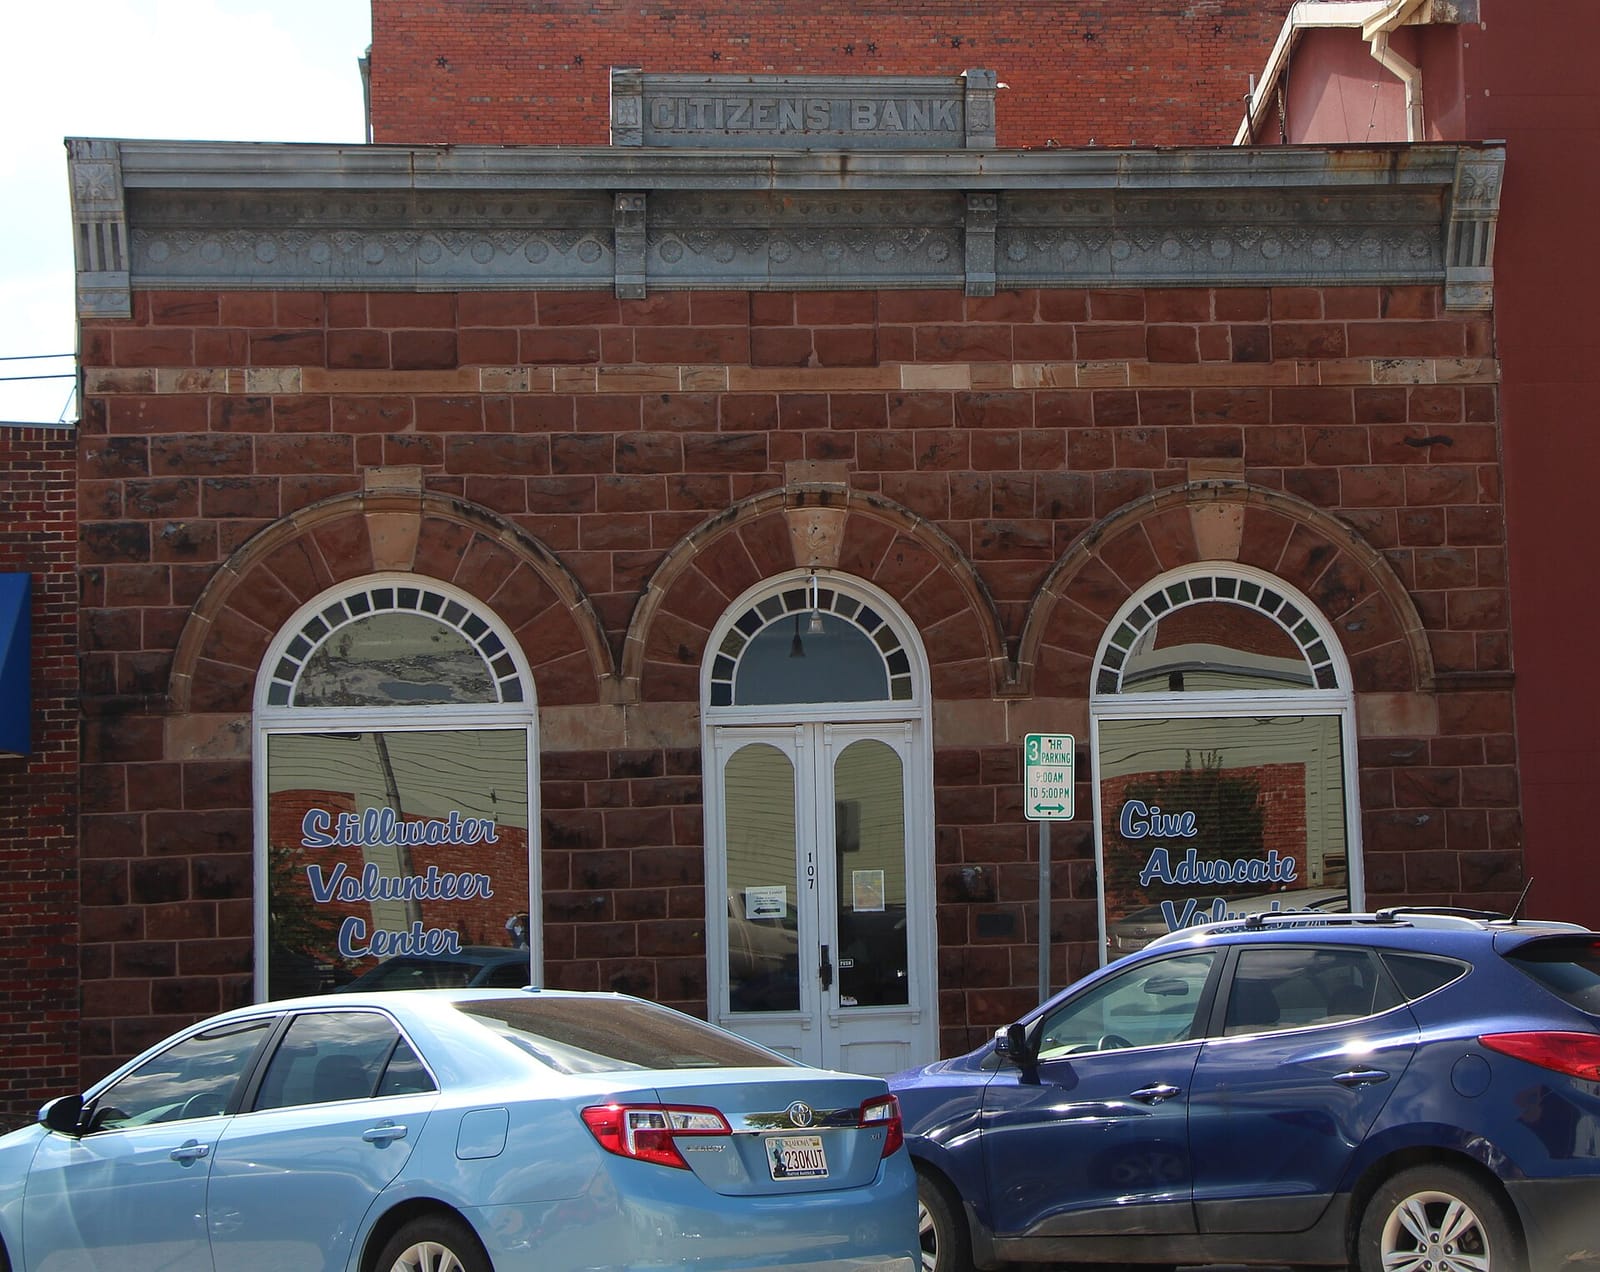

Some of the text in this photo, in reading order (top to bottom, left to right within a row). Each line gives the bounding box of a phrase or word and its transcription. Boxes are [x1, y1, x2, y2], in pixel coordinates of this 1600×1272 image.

[650, 97, 958, 131] CITIZENS BANK
[1029, 740, 1062, 760] 3 HR
[1042, 753, 1070, 764] PARKING
[1030, 788, 1038, 798] TO
[301, 807, 498, 848] Stillwater
[1120, 799, 1197, 839] Give
[306, 862, 494, 903] Volunteer
[807, 852, 815, 890] 107
[1139, 847, 1298, 887] Advocate
[338, 916, 462, 957] Center
[785, 1149, 824, 1170] 230KUT
